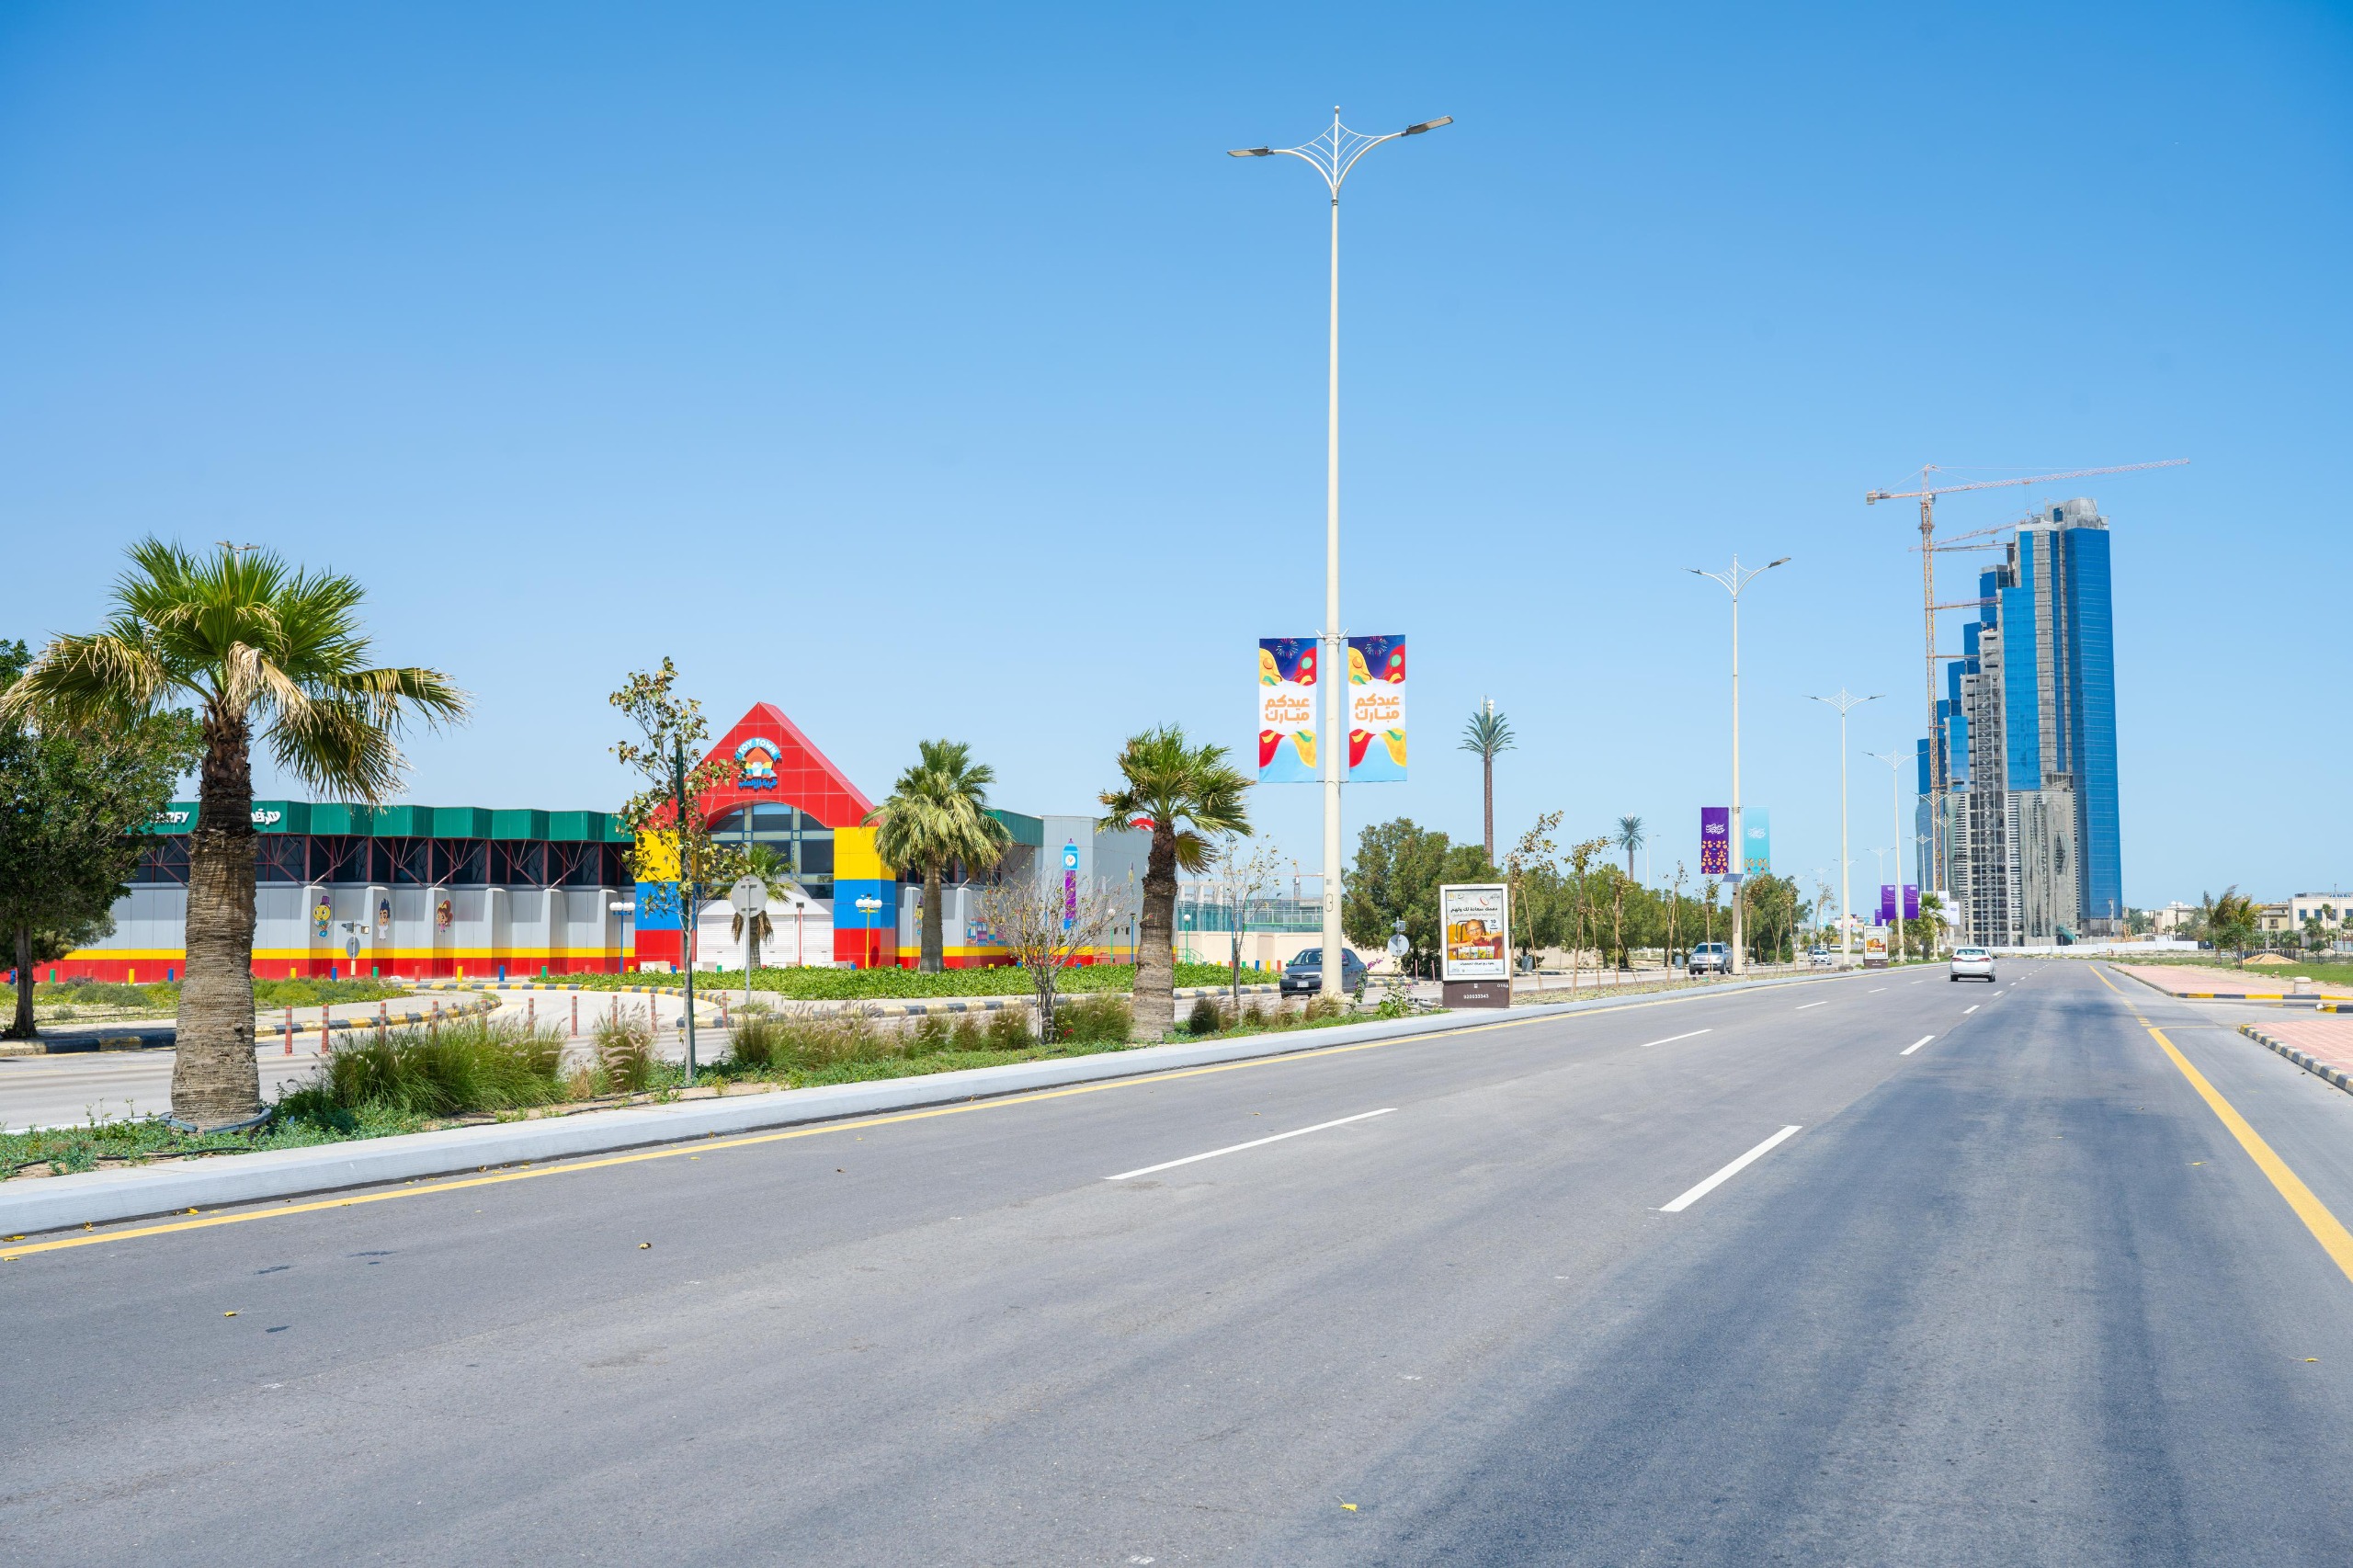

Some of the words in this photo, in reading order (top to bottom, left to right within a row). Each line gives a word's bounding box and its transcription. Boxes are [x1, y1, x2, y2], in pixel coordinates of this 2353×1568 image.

[1265, 694, 1310, 710] عيدكم
[1355, 693, 1400, 710] عيدكم
[1265, 709, 1310, 724] مبارك
[1355, 708, 1400, 723] مبارك
[738, 740, 753, 754] TOY
[755, 738, 778, 754] TOWN
